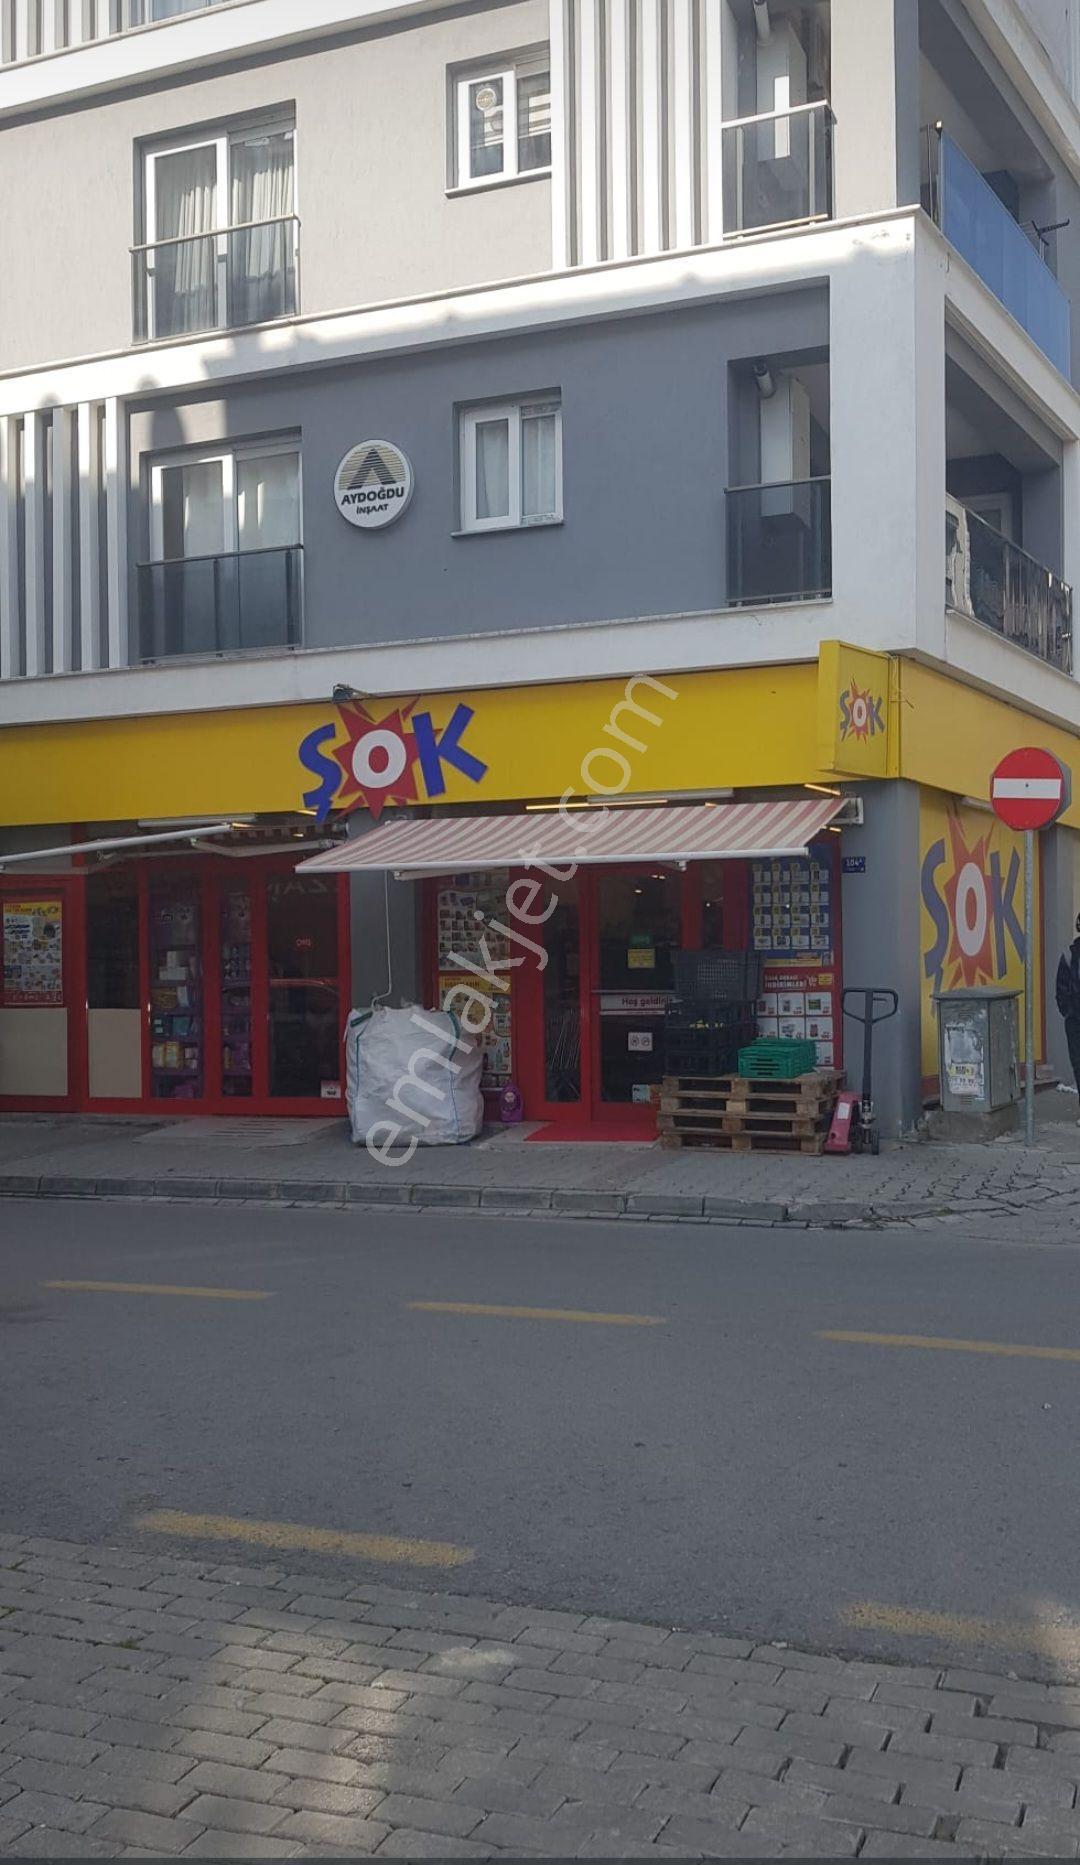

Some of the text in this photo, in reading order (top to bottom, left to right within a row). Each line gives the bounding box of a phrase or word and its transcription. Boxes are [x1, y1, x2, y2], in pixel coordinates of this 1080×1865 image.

[341, 487, 404, 505] AYDOĞDU
[356, 503, 389, 515] İNŞAAT
[839, 690, 885, 742] ŞOK
[299, 703, 488, 825] ŞOK
